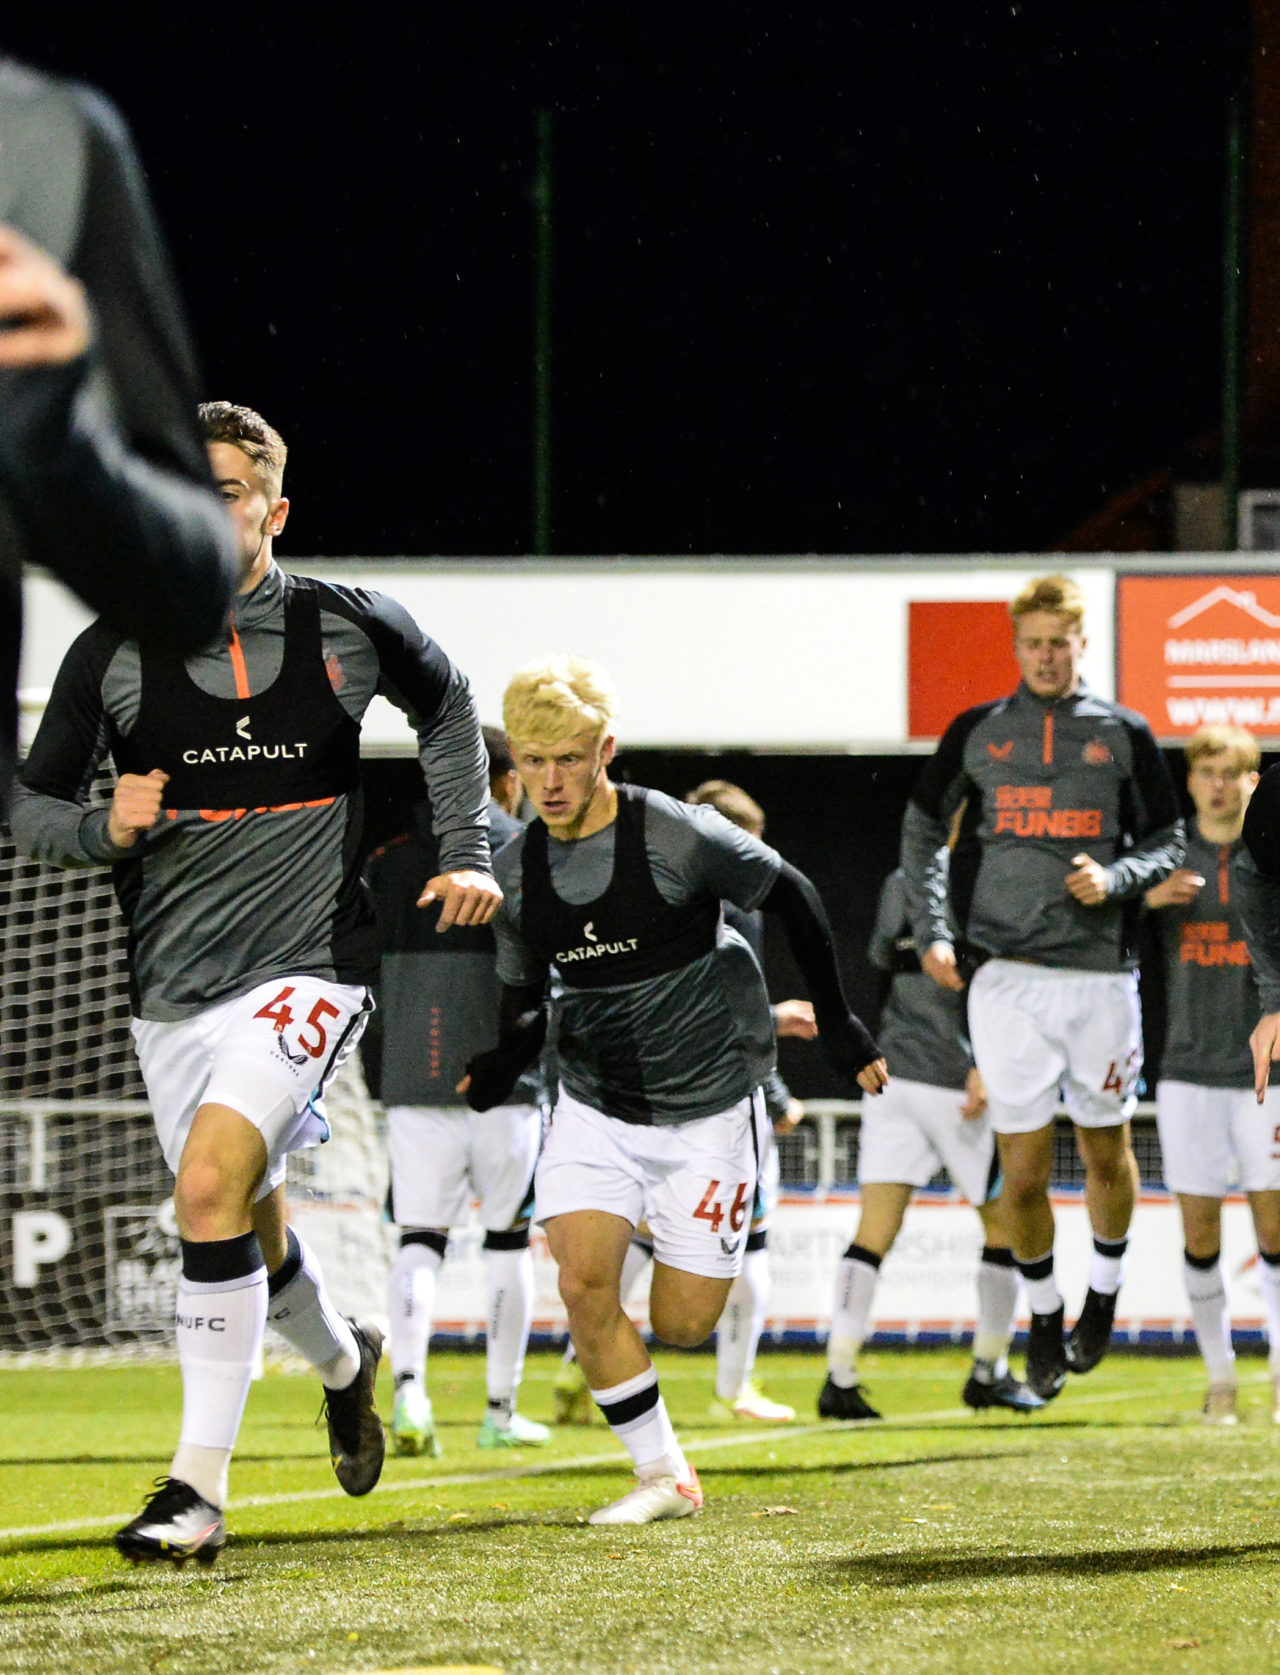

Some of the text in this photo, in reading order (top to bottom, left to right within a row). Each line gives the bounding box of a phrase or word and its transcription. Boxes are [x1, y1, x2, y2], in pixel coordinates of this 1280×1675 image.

[182, 743, 308, 764] CATAPULT
[994, 808, 1102, 838] FUN88
[555, 938, 638, 963] CATAPULT
[252, 986, 340, 1059] 45
[692, 1180, 748, 1233] 46
